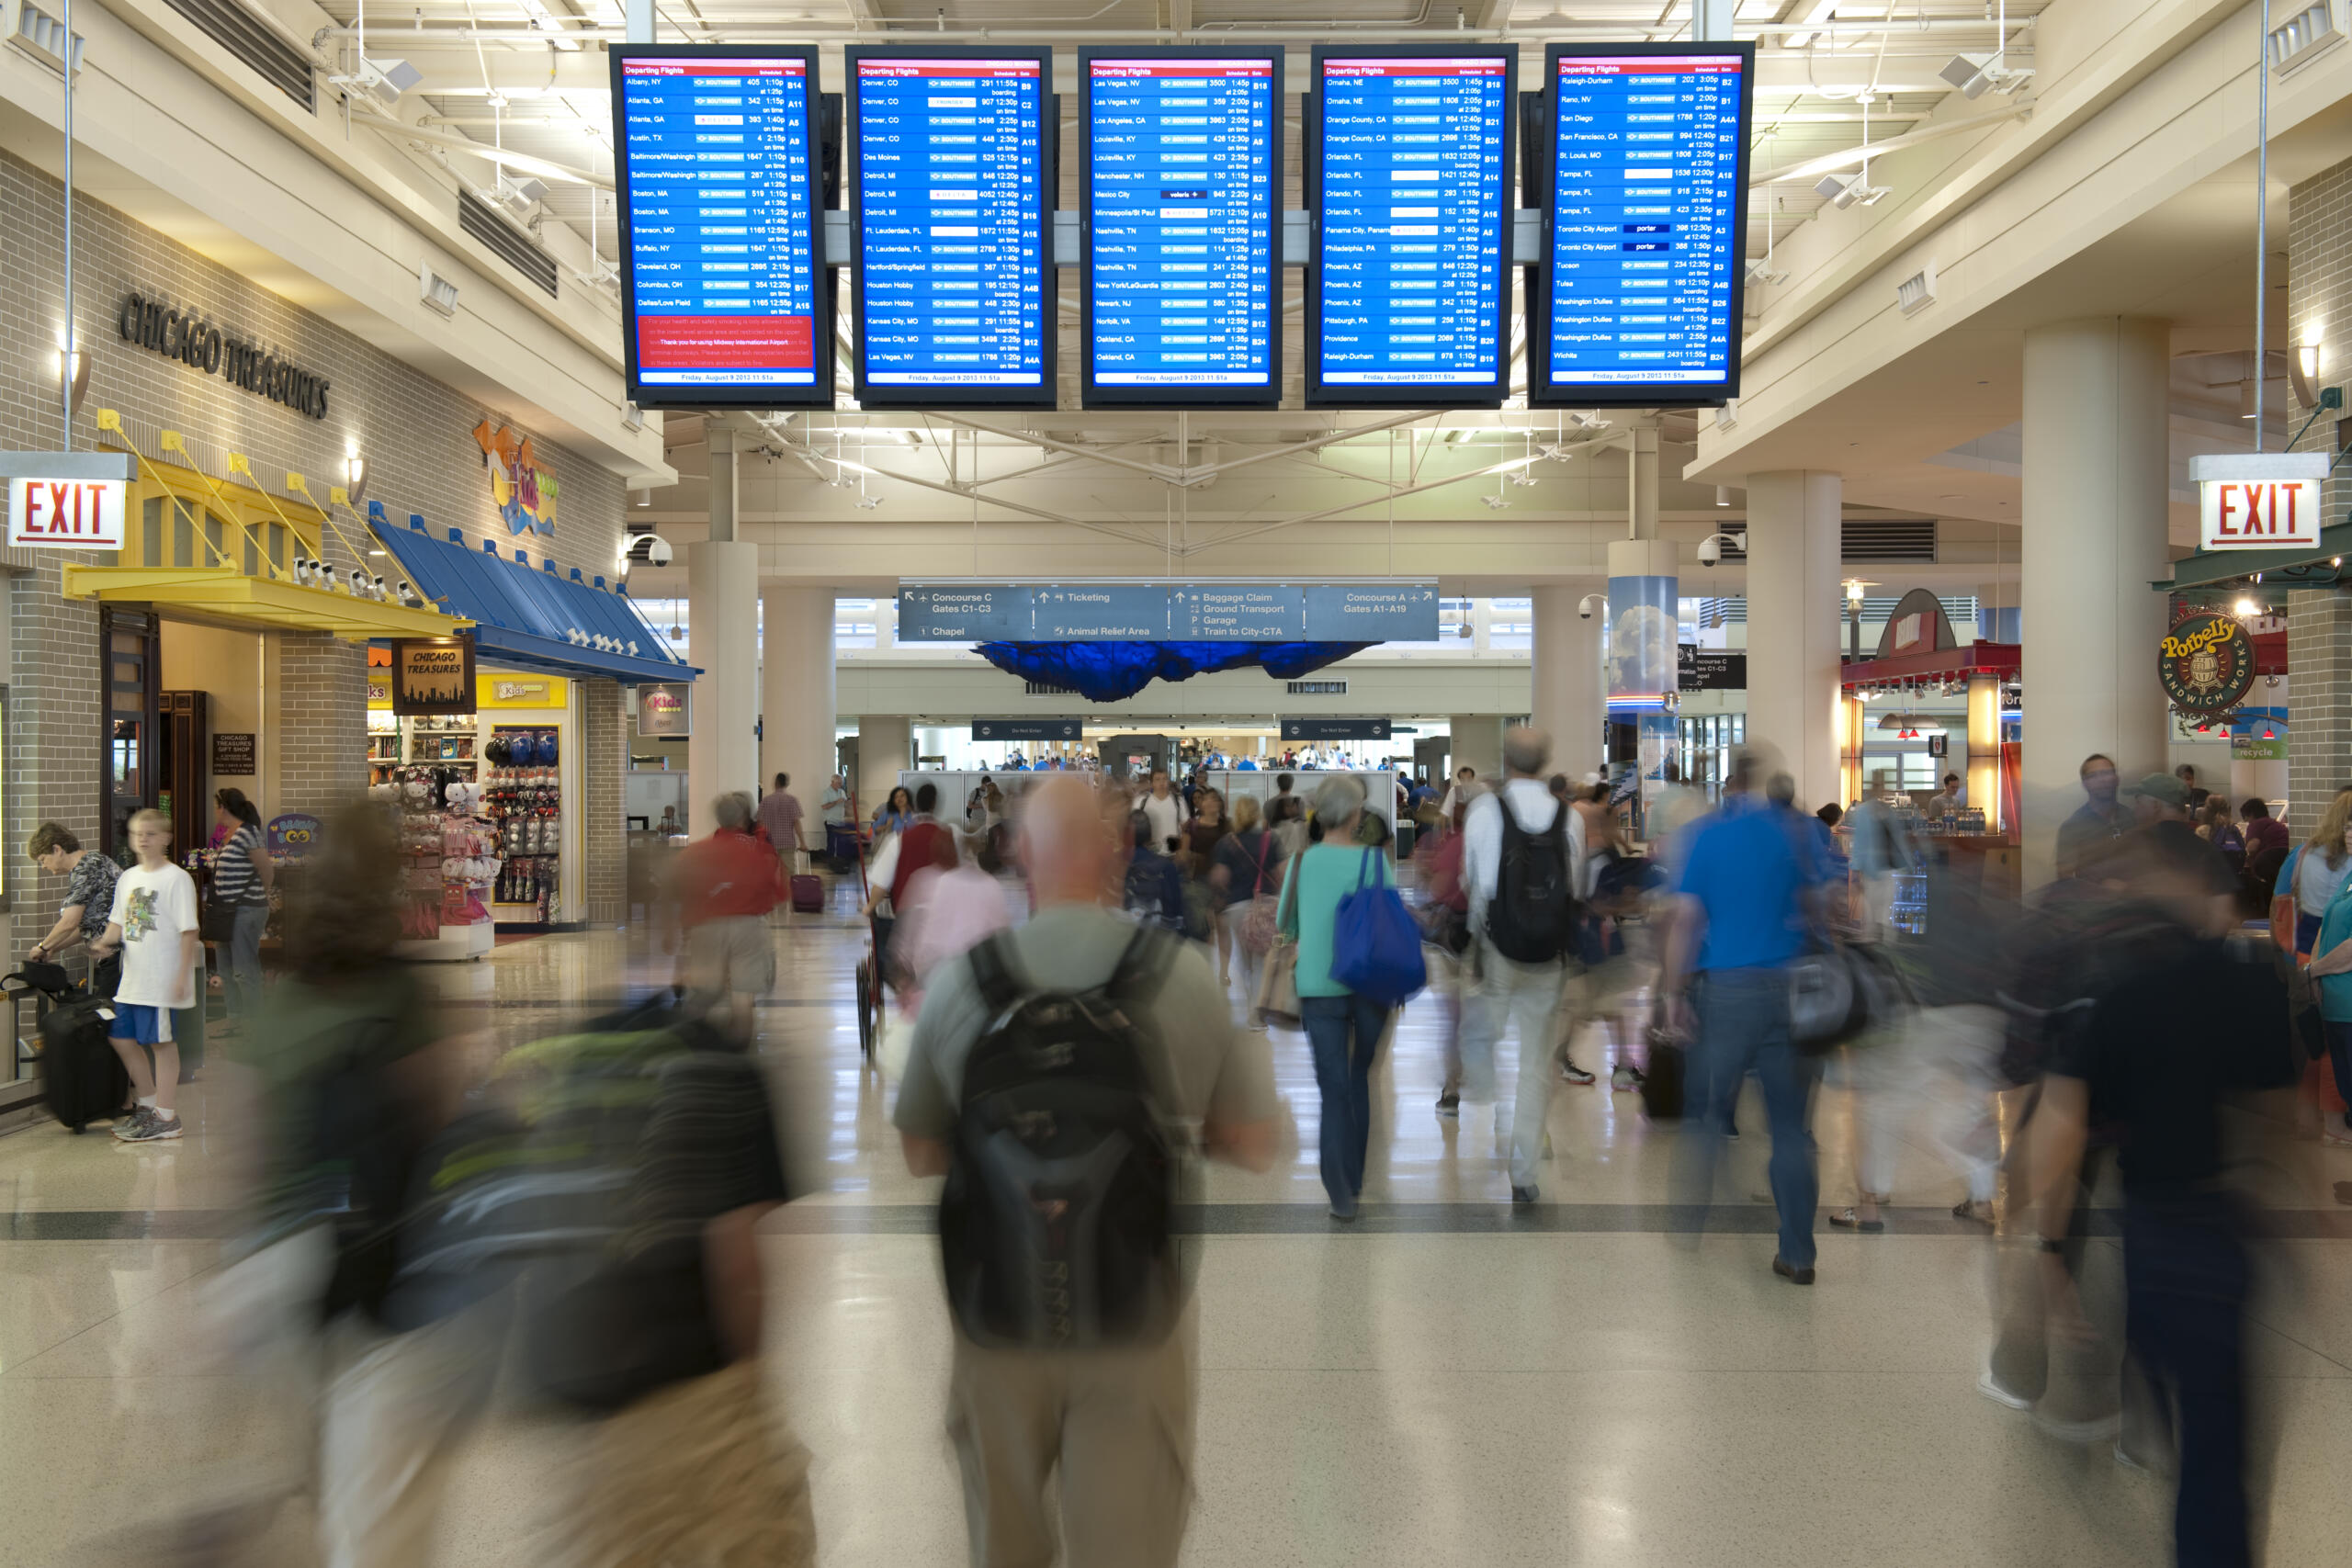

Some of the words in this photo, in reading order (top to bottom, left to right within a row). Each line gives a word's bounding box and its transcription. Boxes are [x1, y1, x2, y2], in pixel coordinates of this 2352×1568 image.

[626, 67, 656, 75] Departing
[657, 67, 684, 75] Flights
[861, 68, 894, 76] Departing
[896, 68, 919, 76] Flights
[1128, 68, 1151, 76] Flights
[1362, 67, 1385, 75] Flights
[1561, 66, 1595, 74] Departing
[1562, 77, 1612, 85] Raleigh-Durham
[1575, 115, 1593, 123] Diego
[866, 264, 925, 272] Hartford/Springfield
[120, 292, 221, 374] CHICAGO
[226, 338, 330, 419] TREASURES
[25, 481, 107, 535] EXIT
[2220, 483, 2302, 535] EXIT
[933, 593, 982, 602] Concourse
[1068, 593, 1110, 603] Ticketing
[1204, 593, 1243, 603] Baggage
[1246, 593, 1272, 602] Claim
[1347, 593, 1396, 602] Concourse
[933, 604, 959, 613] Gates
[962, 604, 991, 613] C1-C3
[1204, 604, 1238, 613] Ground
[1239, 604, 1284, 614] Transport
[1343, 604, 1371, 613] Gates
[1373, 604, 1407, 613] A1-A19
[1204, 616, 1237, 626] Garage
[933, 627, 965, 637] Chapel
[1241, 627, 1283, 637] City-CTA
[2161, 617, 2236, 658] Potbelly
[413, 652, 456, 662] CHICAGO
[407, 664, 461, 674] TREASURES
[2163, 663, 2223, 705] SANDWICH
[2229, 639, 2246, 690] WORKS
[368, 685, 384, 697] ks
[653, 694, 682, 707] Kids
[2240, 748, 2273, 757] recycle
